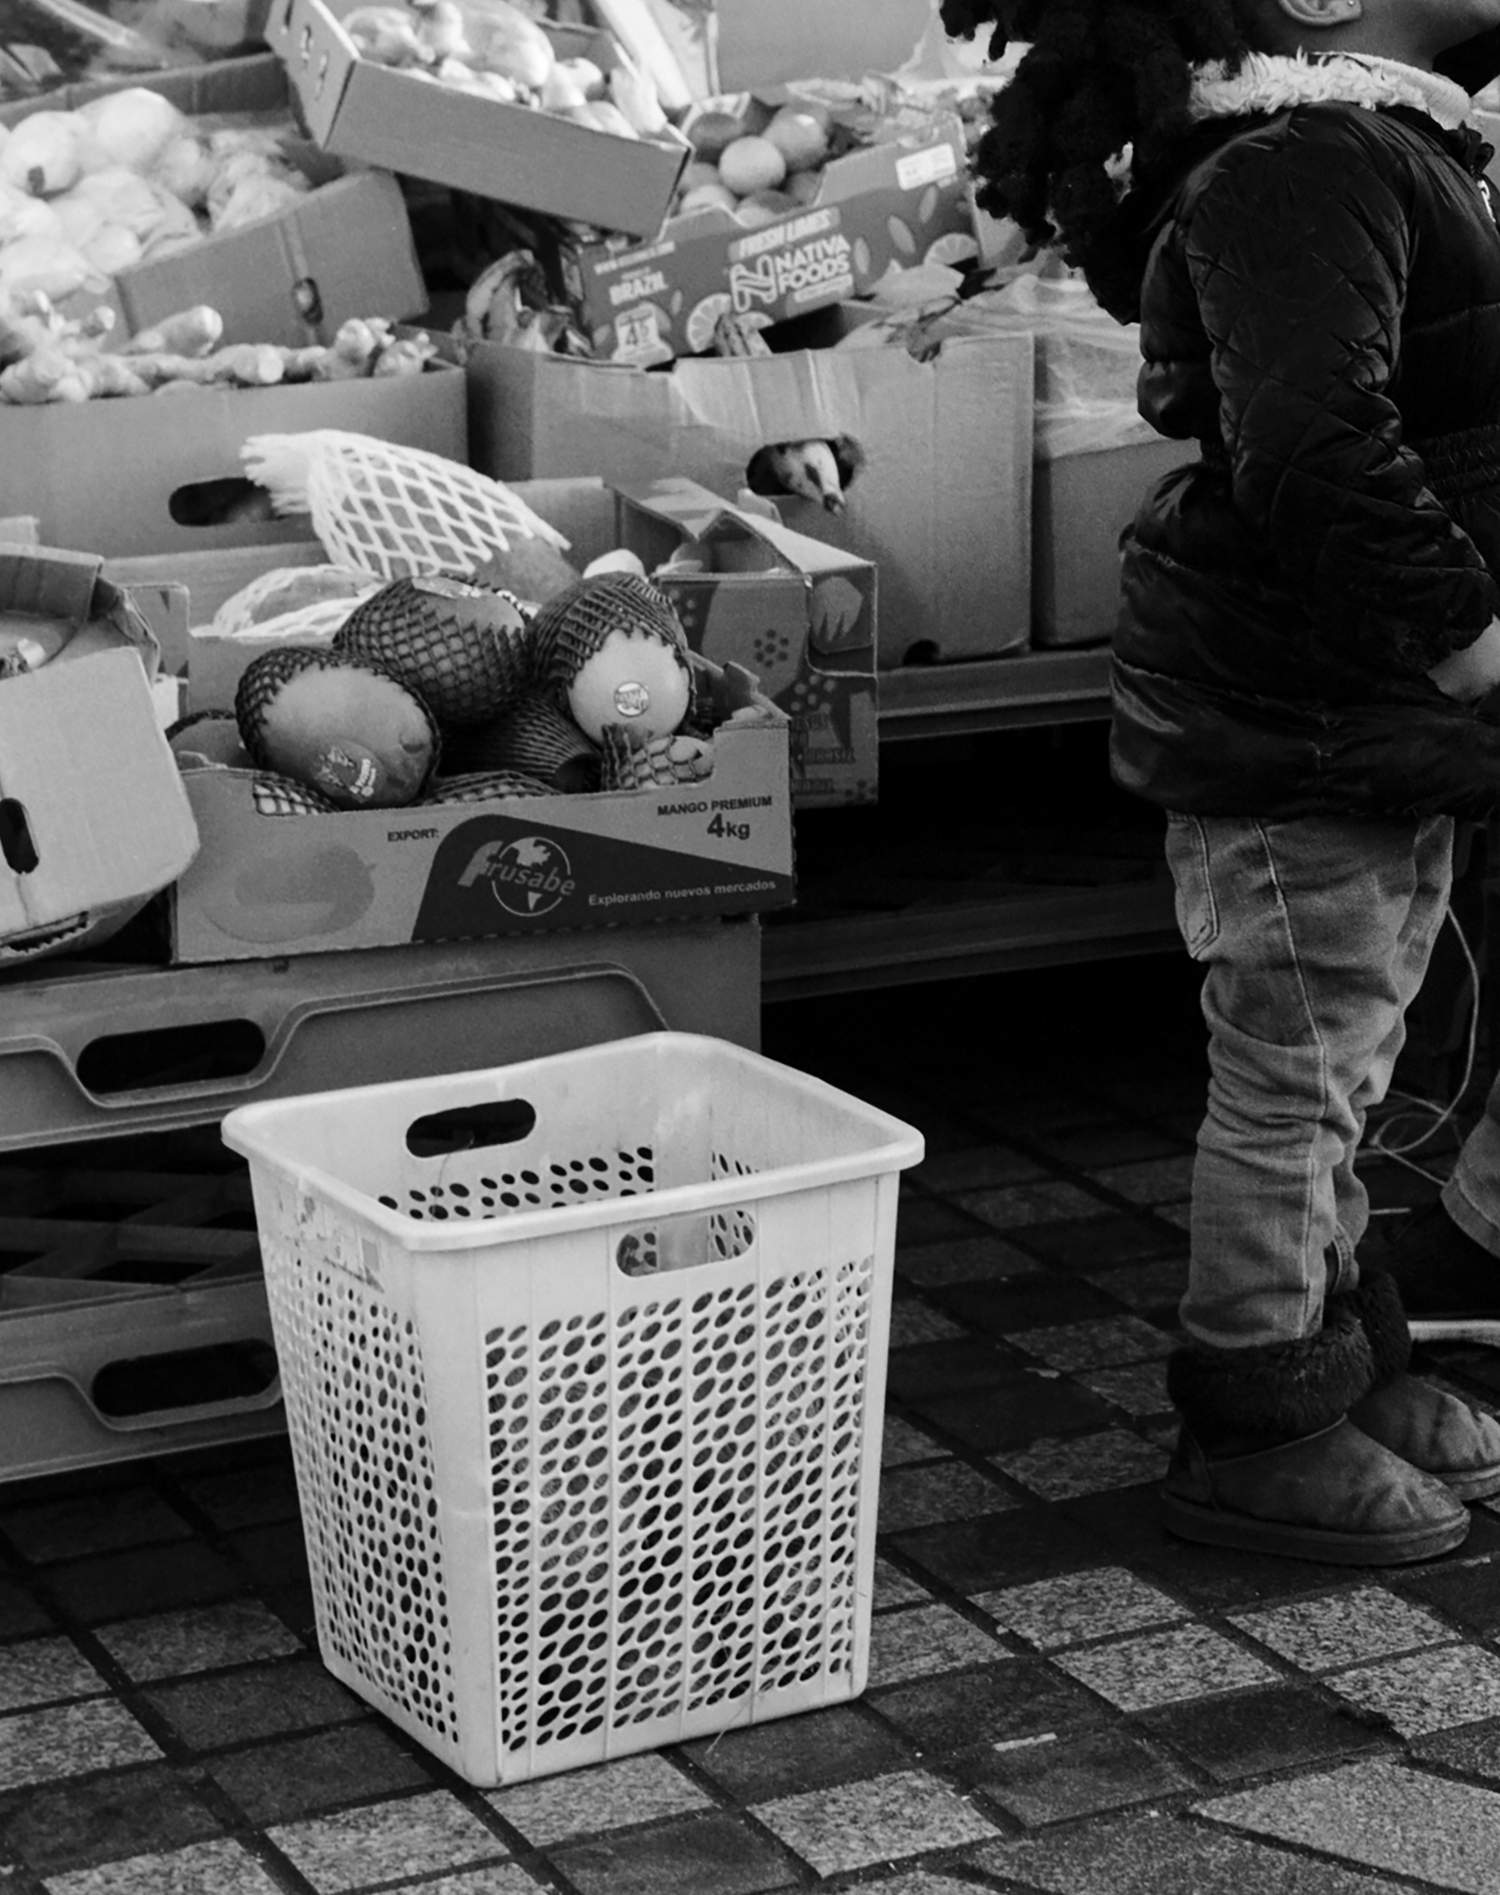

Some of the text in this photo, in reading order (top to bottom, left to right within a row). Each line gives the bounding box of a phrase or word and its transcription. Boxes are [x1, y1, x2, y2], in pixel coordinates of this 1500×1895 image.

[775, 234, 851, 274] NATIVA
[608, 270, 669, 306] BRAZIL
[778, 253, 850, 294] FOODS
[656, 795, 773, 817] MANGO PREMIUM
[386, 827, 440, 844] EXPORT:
[587, 878, 777, 908] Explorando nuevos mercados
